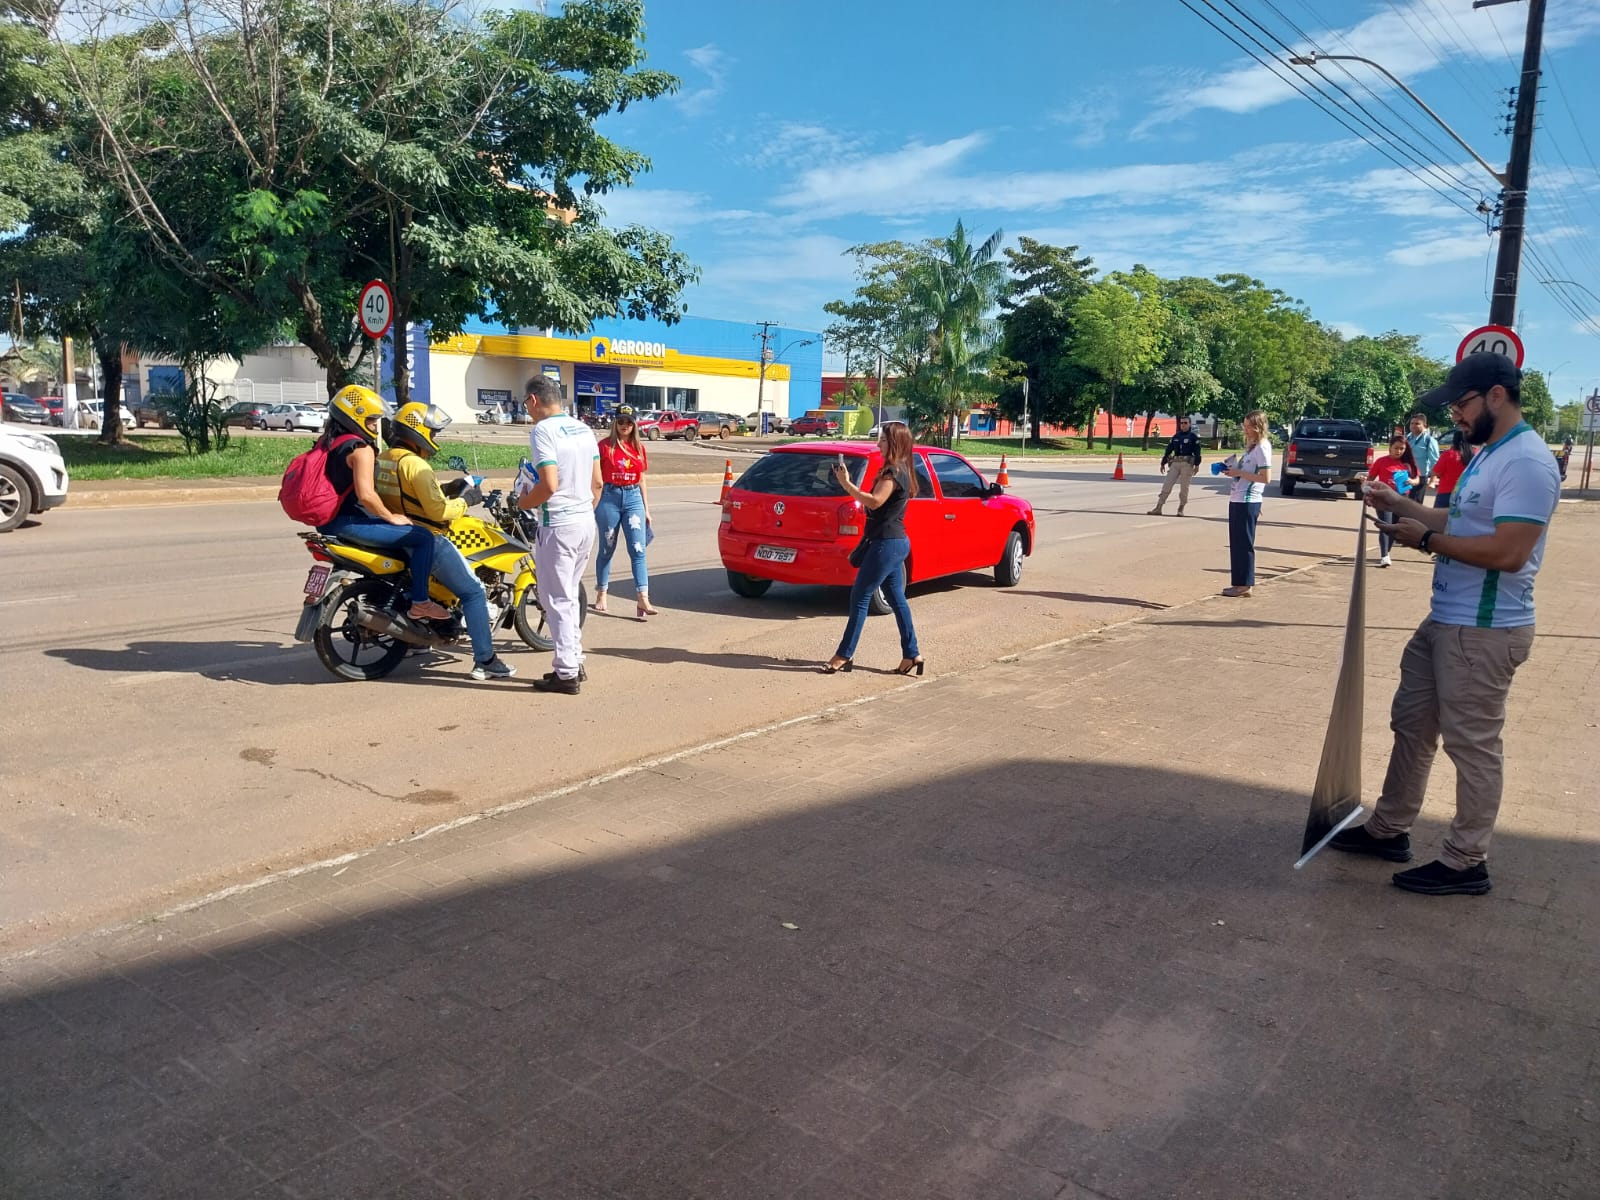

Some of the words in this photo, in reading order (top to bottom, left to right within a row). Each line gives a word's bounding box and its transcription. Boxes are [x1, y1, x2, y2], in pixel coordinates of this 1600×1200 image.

[366, 294, 384, 313] 40
[368, 317, 384, 325] Km/h
[610, 338, 666, 358] AGROBOI
[1470, 340, 1507, 355] 40
